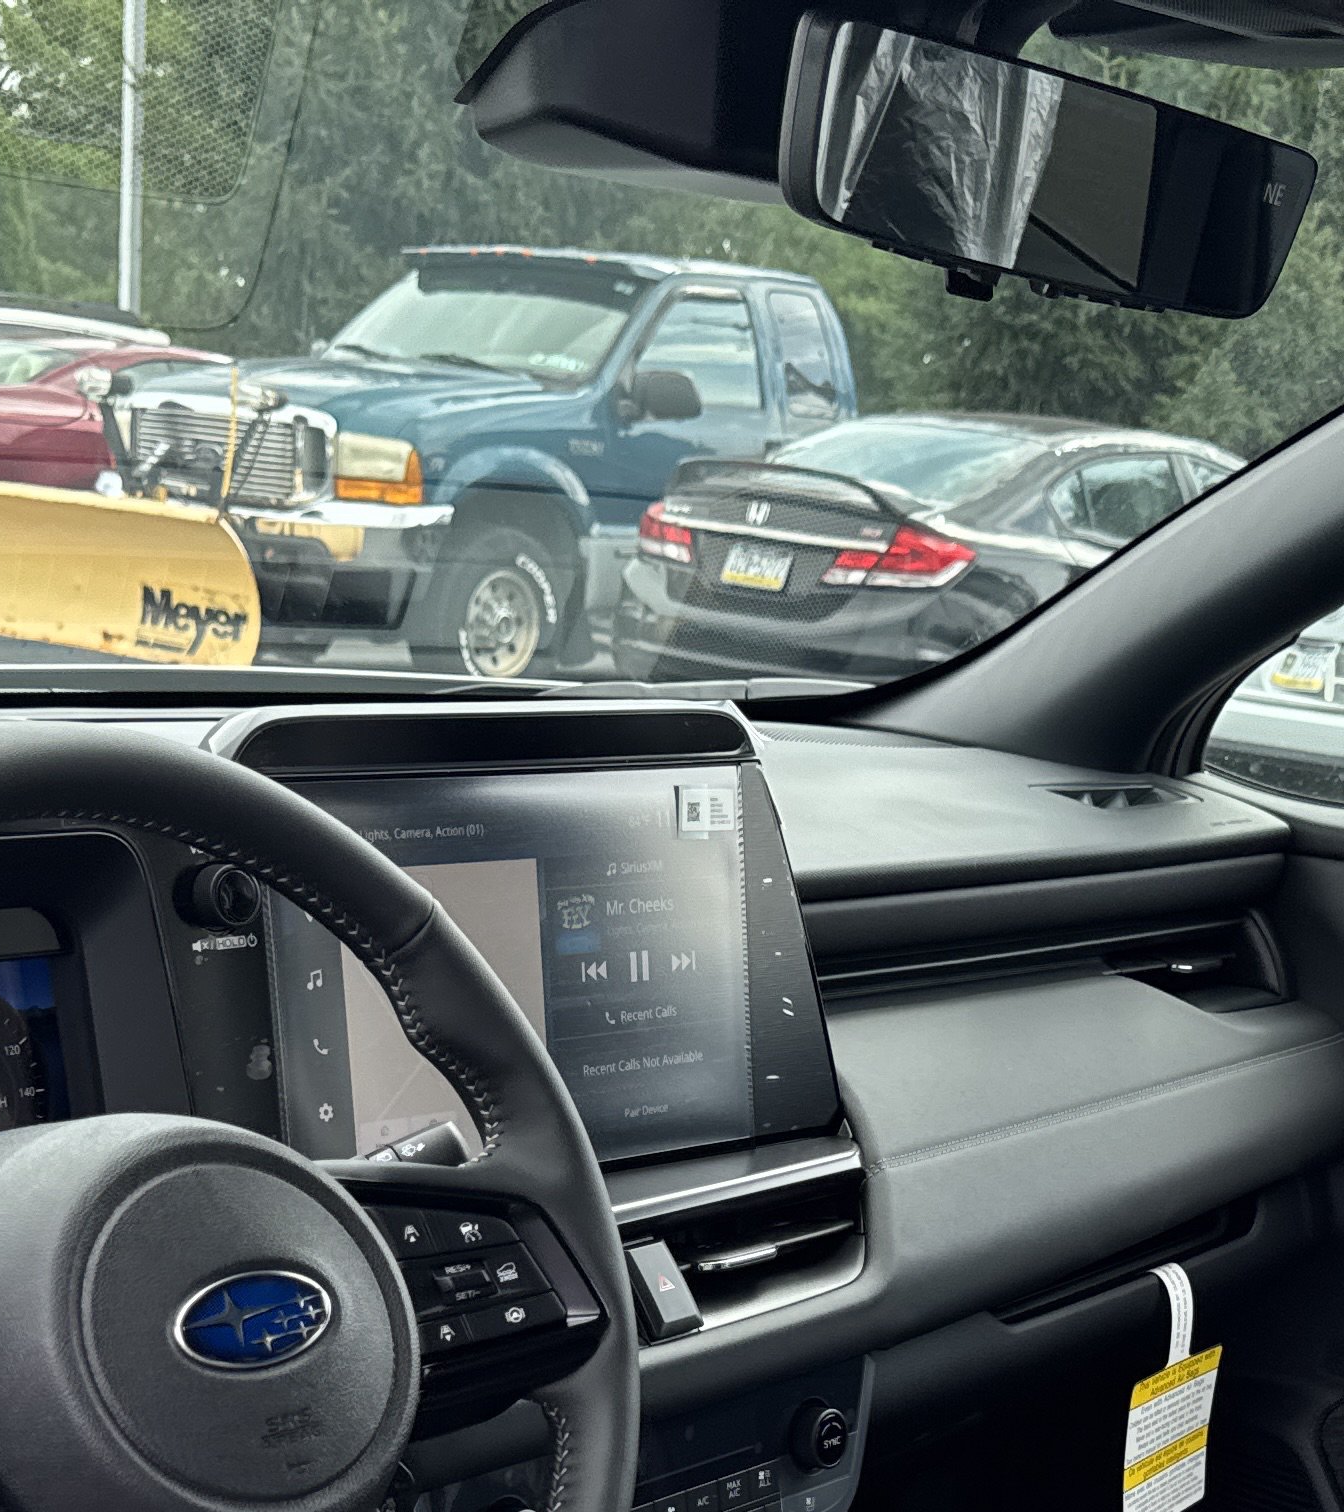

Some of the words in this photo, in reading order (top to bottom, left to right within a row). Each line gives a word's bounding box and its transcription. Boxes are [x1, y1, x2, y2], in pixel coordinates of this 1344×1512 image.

[1263, 182, 1287, 207] NE
[141, 585, 248, 656] Meyer
[393, 827, 433, 840] Camera,
[435, 825, 465, 837] Action
[466, 824, 485, 838] (01)
[621, 859, 663, 875] SiriusXM
[606, 900, 626, 916] Mr.
[629, 896, 675, 914] Cheeks
[620, 1009, 653, 1024] Recent
[655, 1005, 678, 1019] Calls
[4, 1044, 21, 1056] 120
[583, 1062, 616, 1078] Recent
[618, 1058, 641, 1072] Calls
[642, 1056, 661, 1069] Not
[662, 1049, 704, 1067] Available
[18, 1086, 35, 1098] 140
[642, 1103, 669, 1116] Device
[726, 1479, 742, 1490] MAX
[697, 1496, 710, 1507] A/C
